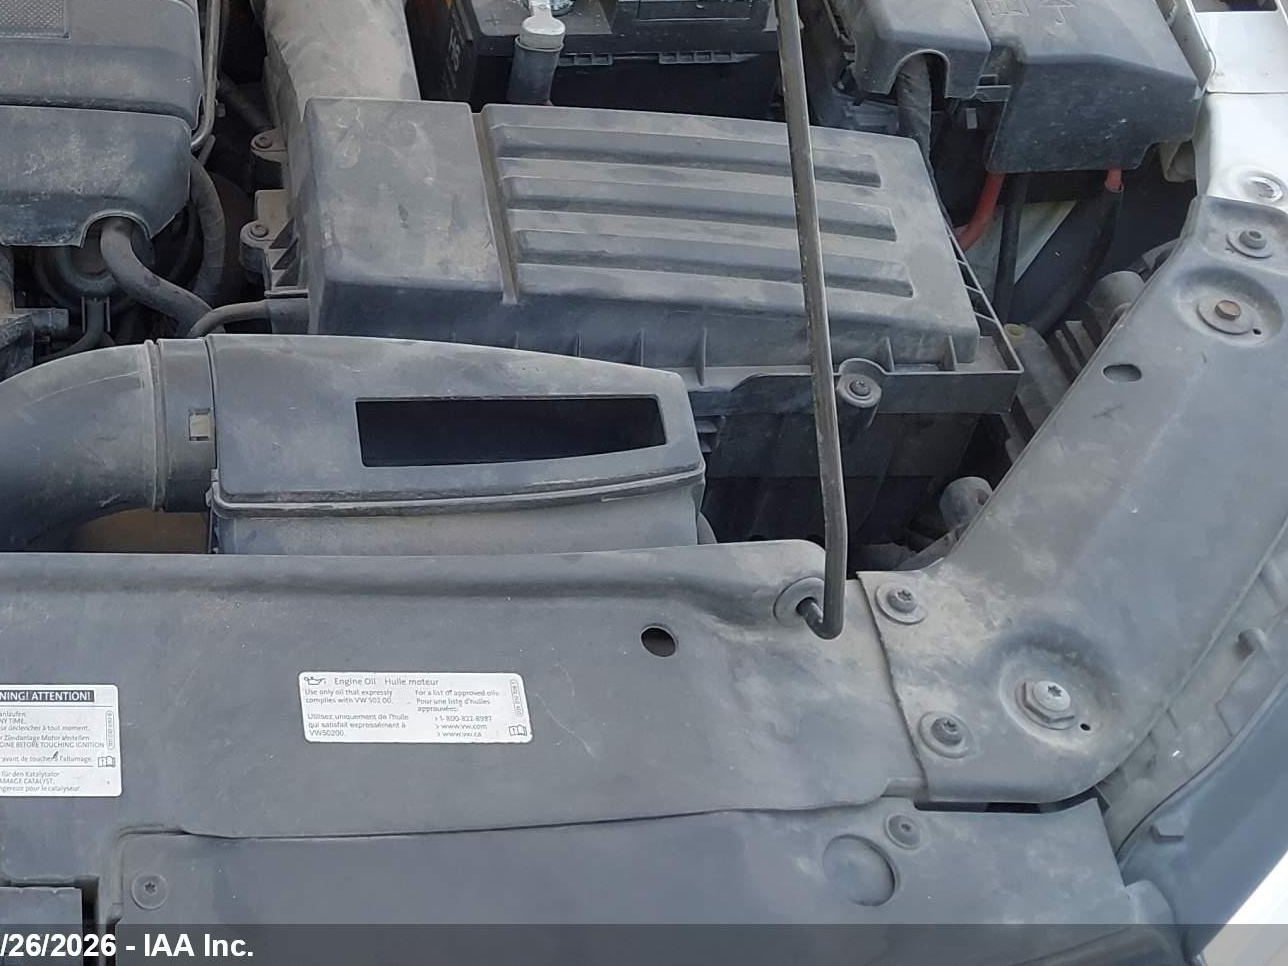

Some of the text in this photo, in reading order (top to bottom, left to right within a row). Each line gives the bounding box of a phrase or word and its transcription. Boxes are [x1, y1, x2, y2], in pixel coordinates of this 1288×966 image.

[334, 677, 376, 686] Engine Oil
[31, 691, 91, 701] ATTENTION!
[306, 697, 336, 705] complies
[308, 721, 320, 729] qui
